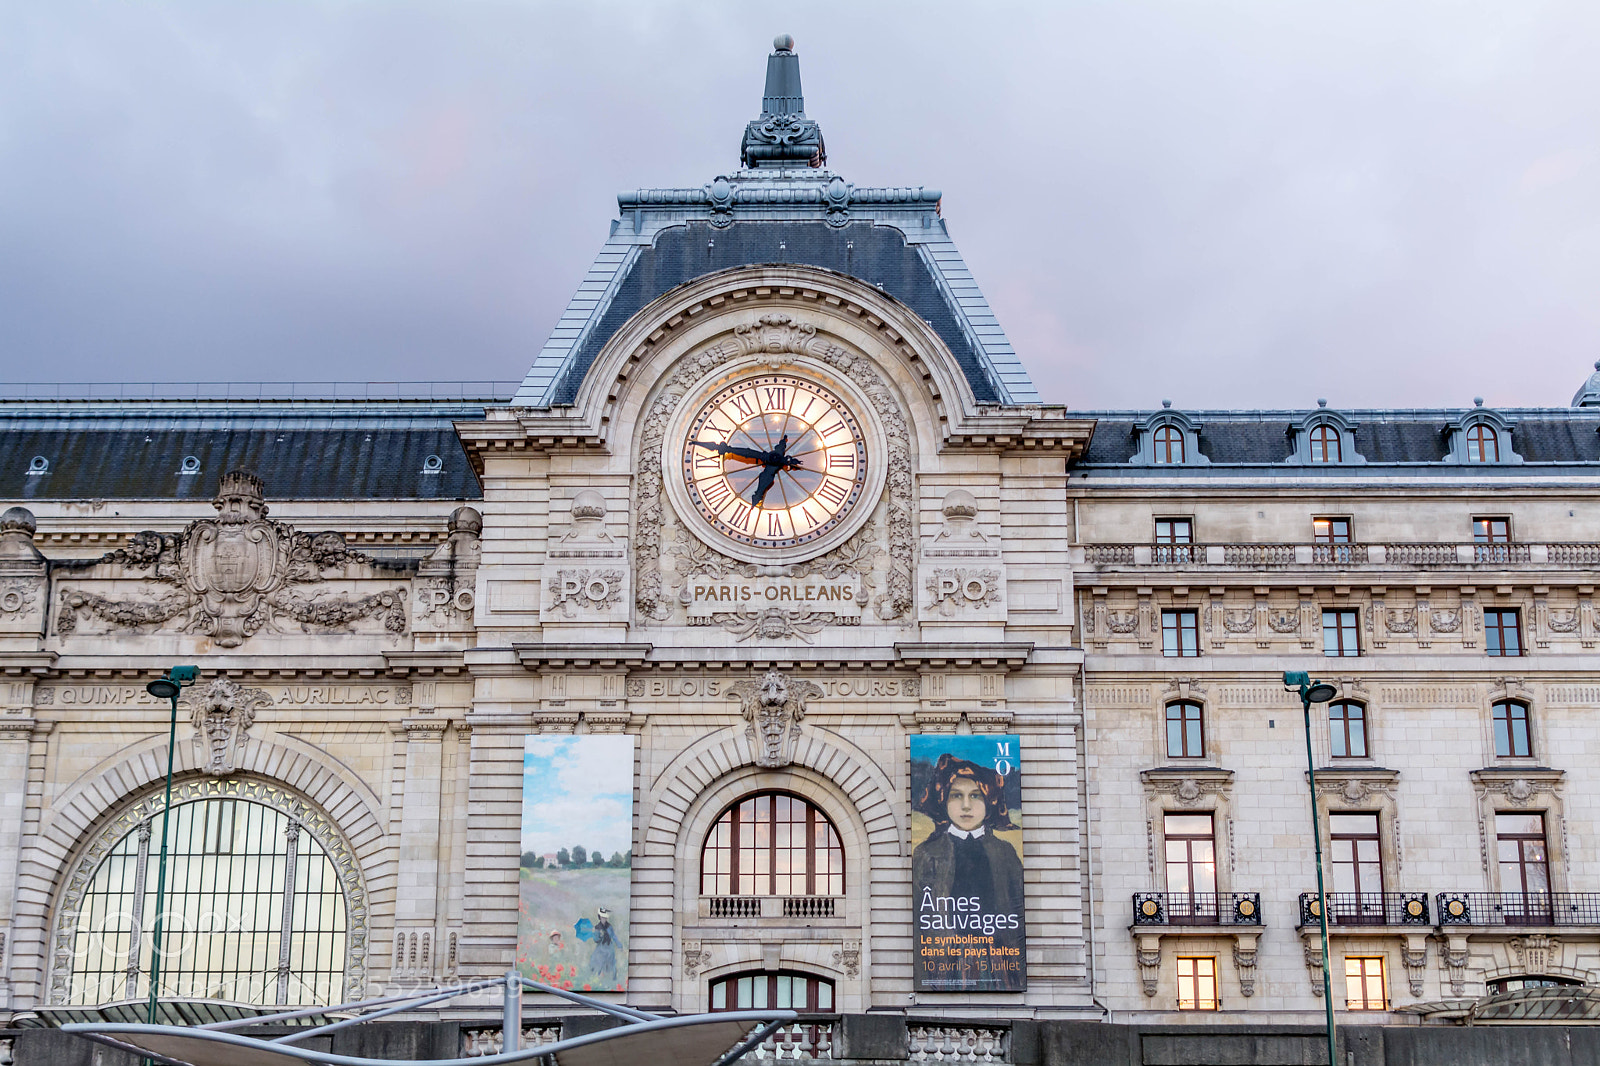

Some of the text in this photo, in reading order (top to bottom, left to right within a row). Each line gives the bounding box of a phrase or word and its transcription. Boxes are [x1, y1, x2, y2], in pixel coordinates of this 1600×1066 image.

[729, 394, 755, 421] XI
[764, 387, 786, 411] XII
[802, 396, 817, 417] I
[704, 419, 731, 440] X
[820, 420, 846, 440] II
[695, 452, 721, 469] IX
[829, 453, 855, 469] III
[701, 479, 731, 512] VIII
[817, 479, 849, 507] IIII
[727, 502, 755, 532] VII
[767, 513, 784, 537] VI
[802, 506, 820, 529] V
[561, 577, 610, 602] PO
[938, 576, 987, 602] PO
[430, 588, 475, 612] PO
[61, 687, 168, 704] QUIMPE
[278, 687, 389, 704] AURILLAC
[650, 679, 721, 697] BLOIS
[823, 679, 899, 697] TOURS
[920, 886, 980, 912] Âmes
[920, 913, 1019, 935] sauvages
[920, 934, 994, 946] Le symbolisme
[920, 946, 1020, 958] dans les pays baltes
[922, 961, 935, 971] 10
[938, 961, 961, 971] avril
[975, 961, 988, 971] 15
[990, 960, 1020, 973] juillet
